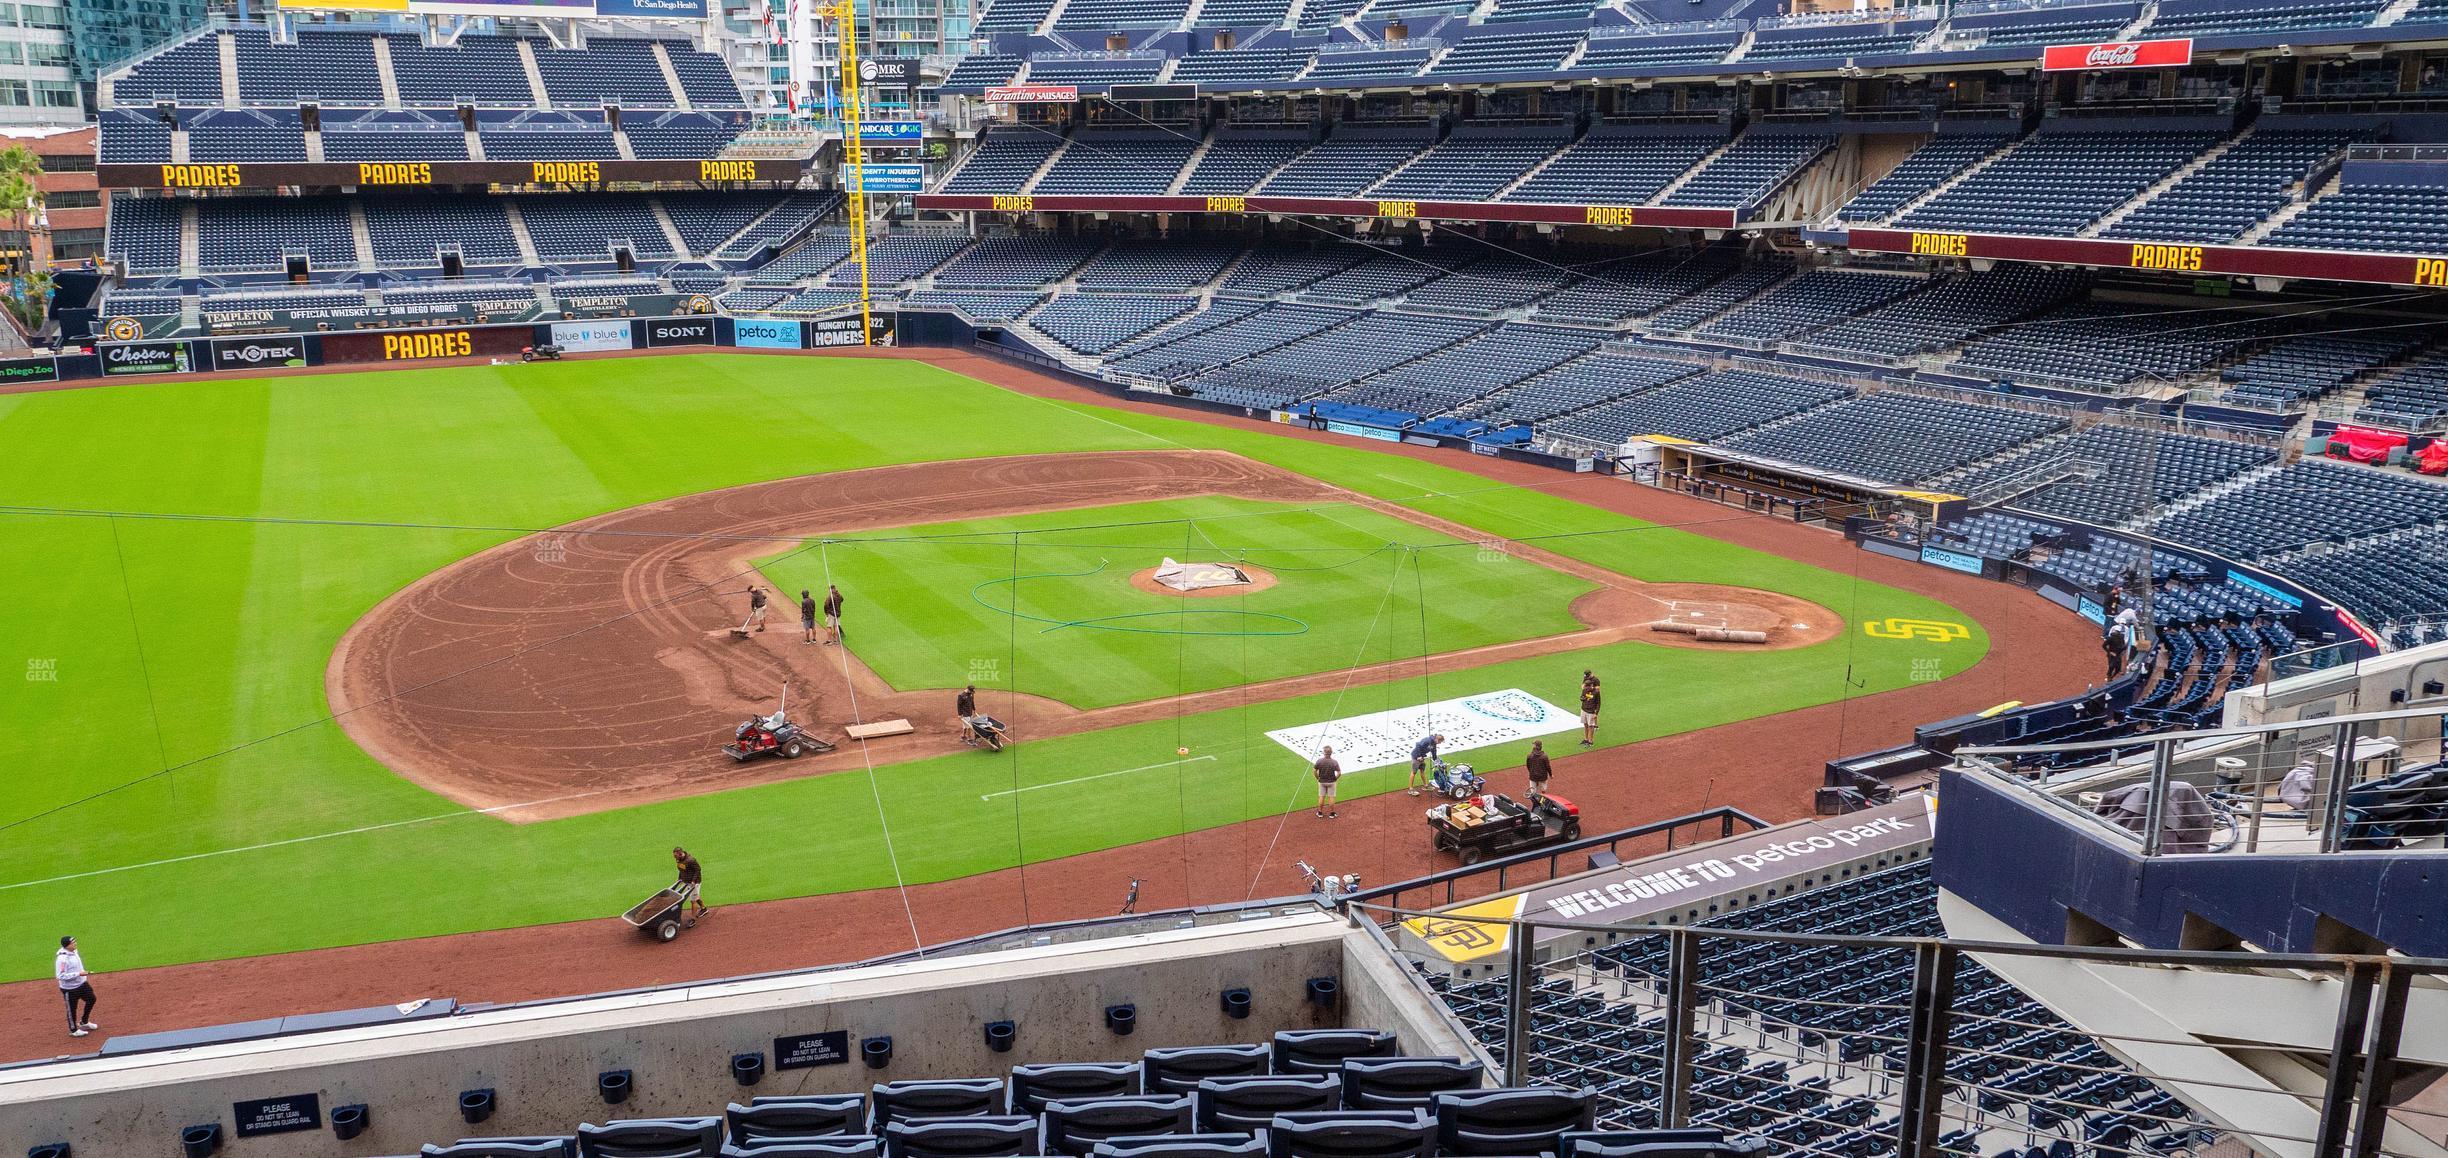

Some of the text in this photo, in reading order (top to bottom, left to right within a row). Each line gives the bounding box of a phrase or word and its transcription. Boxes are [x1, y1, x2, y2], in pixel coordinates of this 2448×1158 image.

[633, 0, 698, 10] UC San Diego Health
[878, 64, 905, 74] MRC
[987, 89, 1075, 100] Tarantino SAUSAGES
[859, 124, 920, 133] ANDCARE LOGIC
[161, 164, 241, 187] PADRES
[359, 163, 432, 185] PADRES
[533, 161, 600, 182] PADRES
[701, 160, 756, 181] PADRES
[993, 196, 1033, 210] PADRES
[1207, 197, 1245, 212] PADRES
[1378, 201, 1416, 218] PADRES
[1586, 207, 1632, 225] PADRES
[1912, 232, 1968, 256] PADRES
[2131, 244, 2203, 271] PADRES
[472, 301, 532, 312] TEMPLETON
[570, 297, 628, 308] TEMPLETON
[205, 311, 274, 323] TEMPLETON
[290, 309, 330, 320] OFFICIAL
[332, 308, 370, 318] WHISKEY
[390, 306, 406, 315] SAN
[407, 305, 429, 314] DIEGO
[430, 304, 458, 313] PADRES
[818, 320, 860, 330] HUNGRY FOR
[869, 318, 884, 328] 322
[555, 331, 579, 341] blue
[593, 329, 617, 340] blue
[656, 327, 706, 338] SONY
[739, 325, 776, 340] petco
[815, 330, 865, 346] HOMERS
[384, 332, 472, 360] PADRES
[109, 346, 170, 362] Chosen
[222, 345, 296, 363] EVOTEK
[6, 367, 34, 376] Diego
[34, 366, 53, 374] Zoo
[1328, 422, 1345, 431] petco
[1364, 428, 1381, 437] petco
[1923, 548, 1951, 562] petco
[2081, 600, 2100, 617] petco
[1546, 816, 1915, 919] WELCOME TO petco park
[799, 1039, 824, 1049] PLEASE
[263, 1103, 291, 1113] PLEASE
